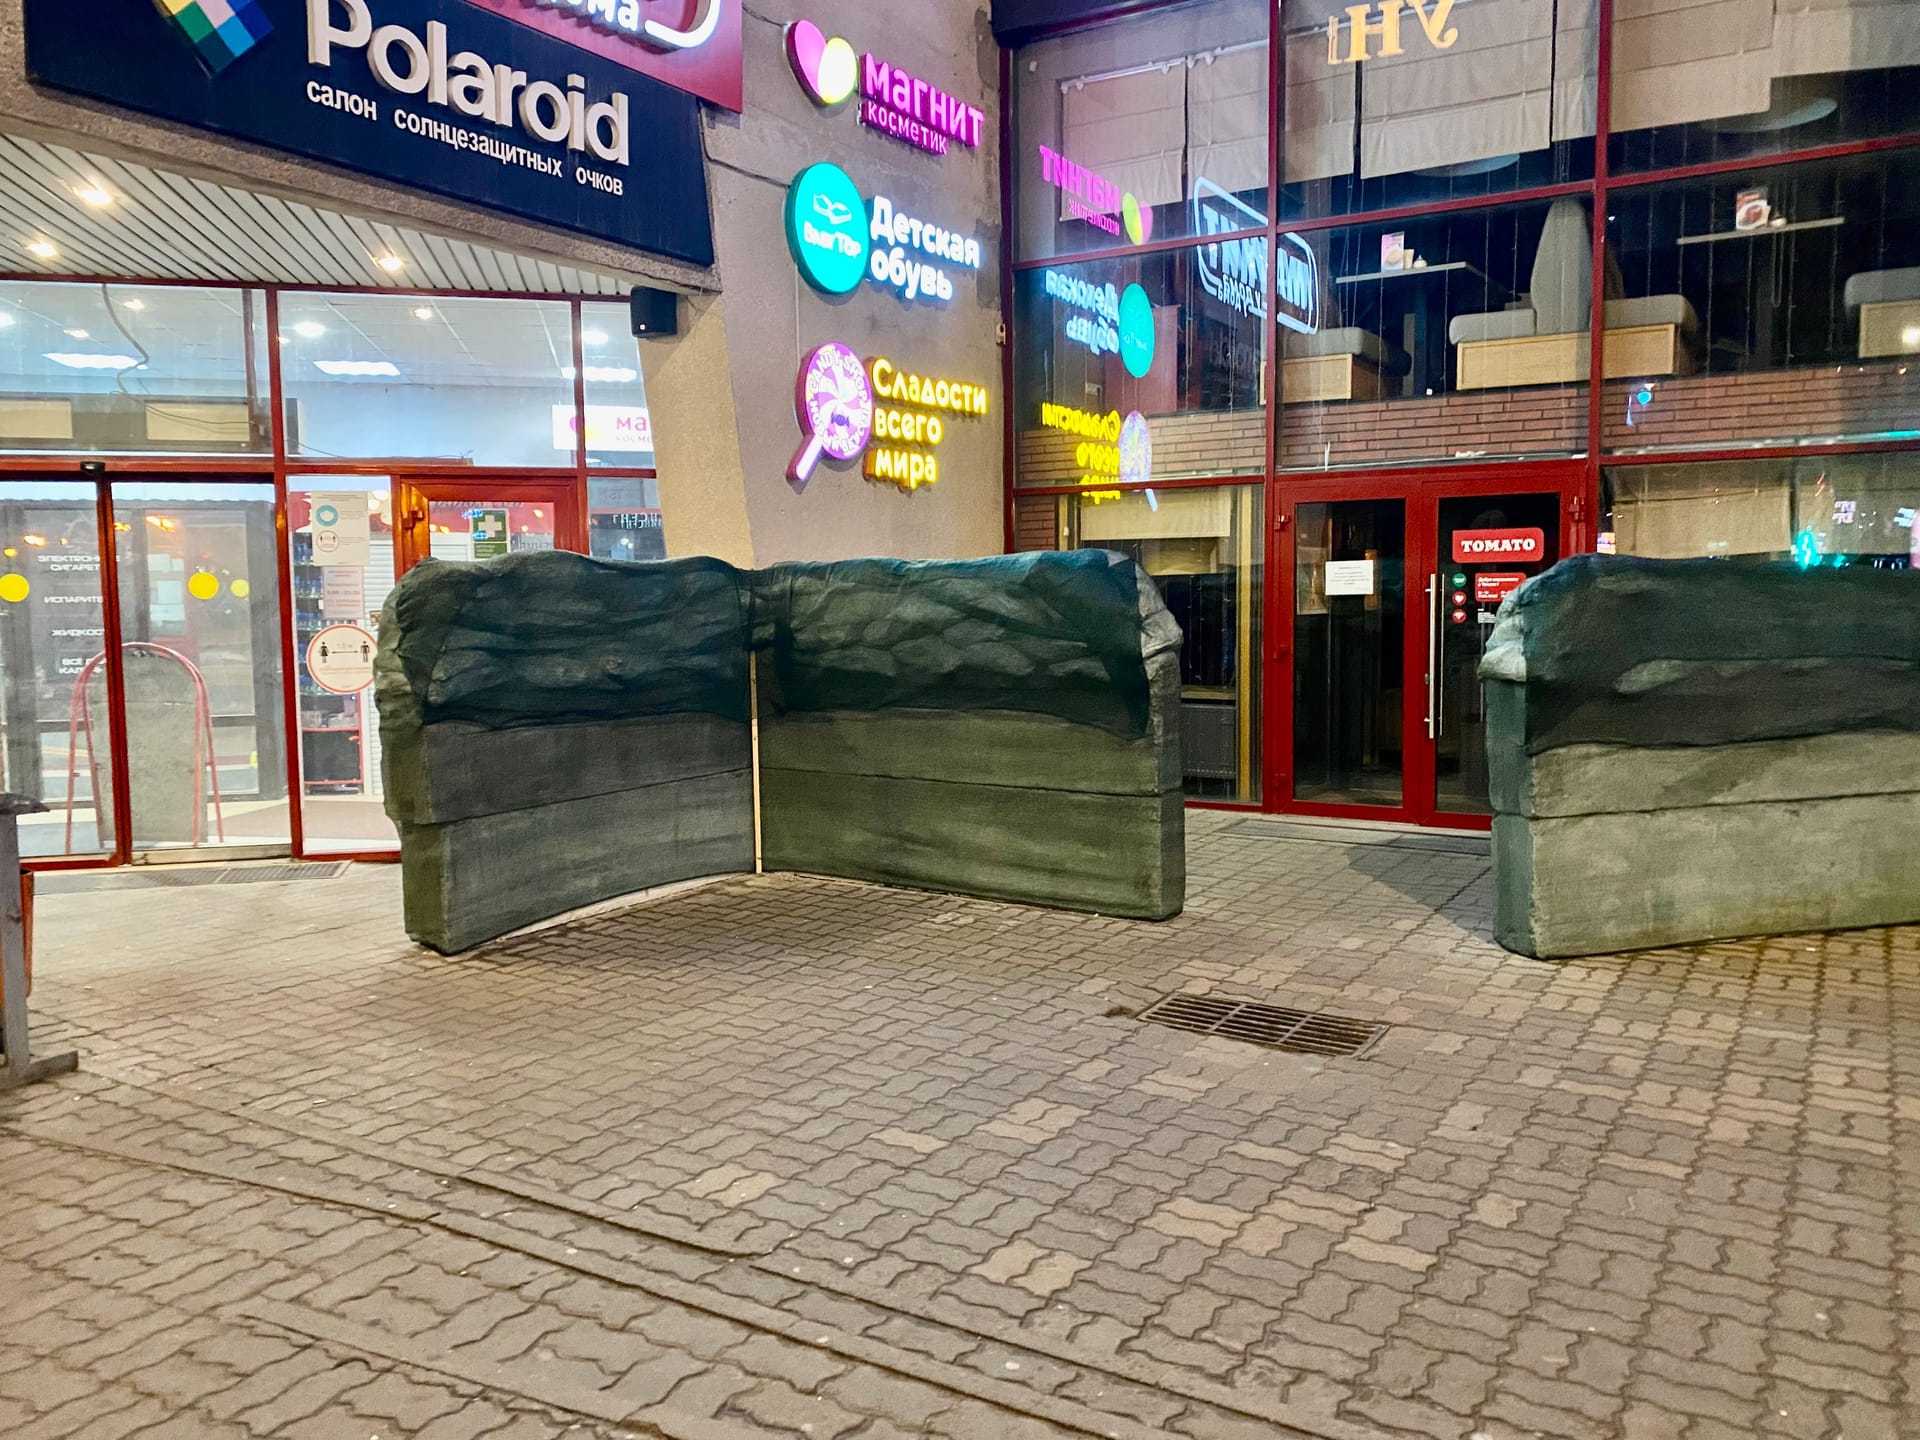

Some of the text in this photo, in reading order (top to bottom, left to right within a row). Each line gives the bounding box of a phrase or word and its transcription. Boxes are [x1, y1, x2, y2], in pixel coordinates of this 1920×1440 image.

[306, 0, 629, 166] Polaroid
[306, 80, 624, 196] салон солнцезащитных очков
[867, 101, 948, 154] косметик
[870, 195, 981, 268] Детская
[870, 247, 953, 300] обувь
[872, 358, 987, 415] Сладости
[874, 407, 943, 445] всего
[875, 448, 939, 490] мира
[1461, 538, 1536, 553] TOMATO
